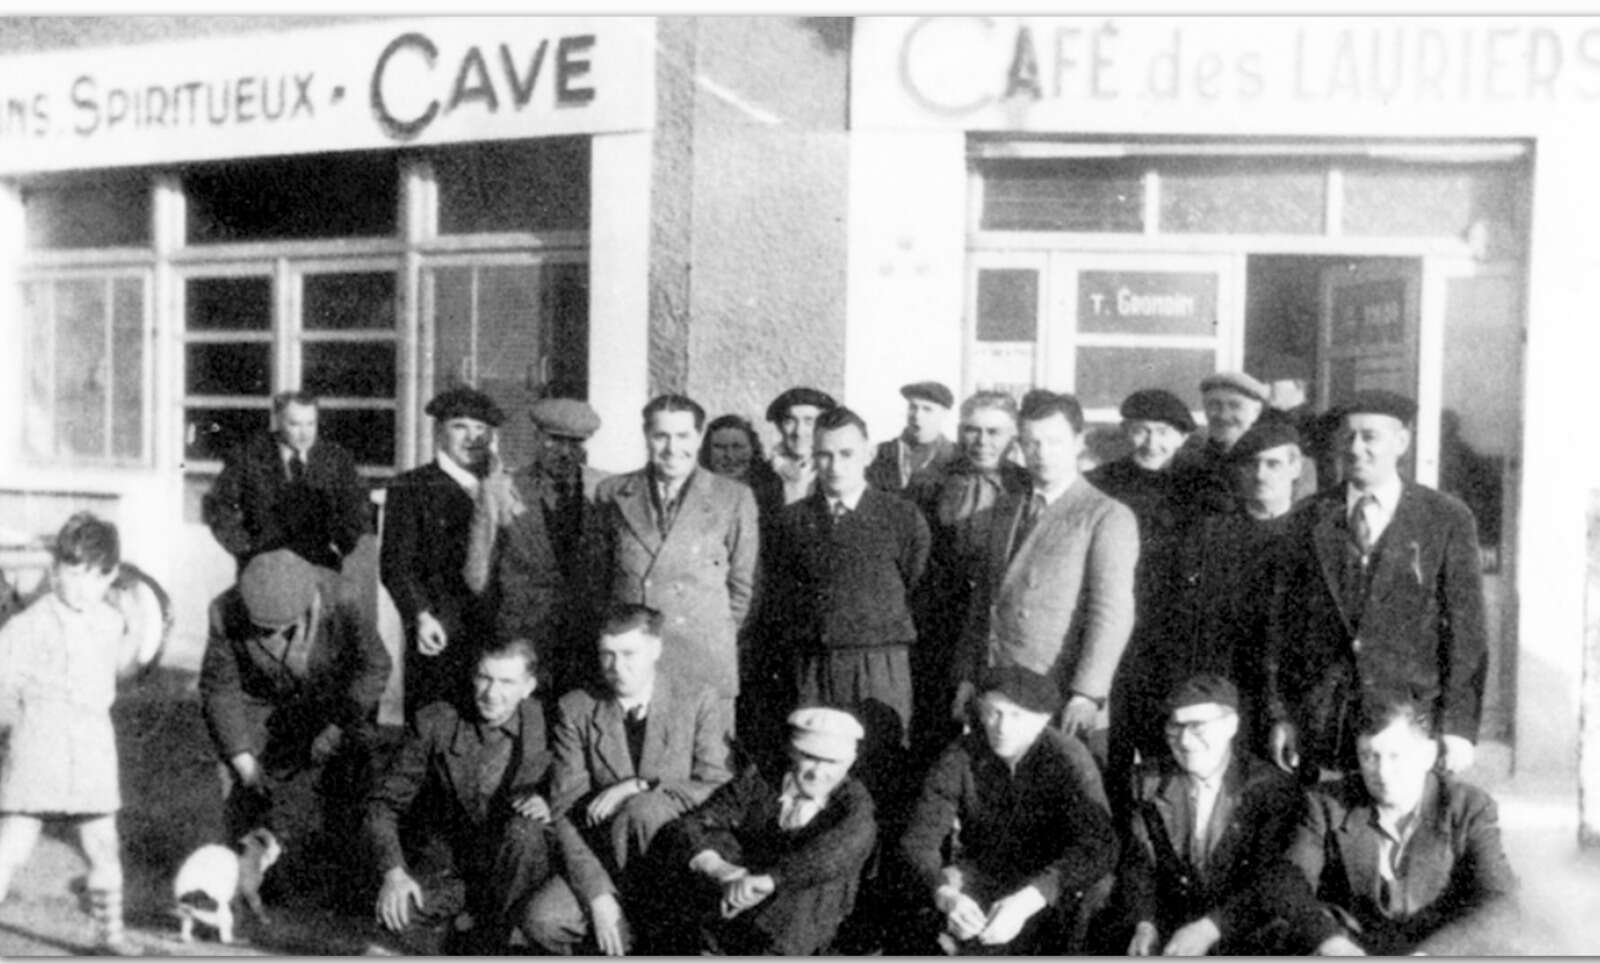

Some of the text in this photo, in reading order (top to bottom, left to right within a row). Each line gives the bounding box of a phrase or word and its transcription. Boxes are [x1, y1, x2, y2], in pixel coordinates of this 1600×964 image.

[70, 73, 316, 137] SPIRITUEUX
[370, 32, 596, 141] CAVE
[897, 16, 1600, 118] CAFÉ des LAURIERS
